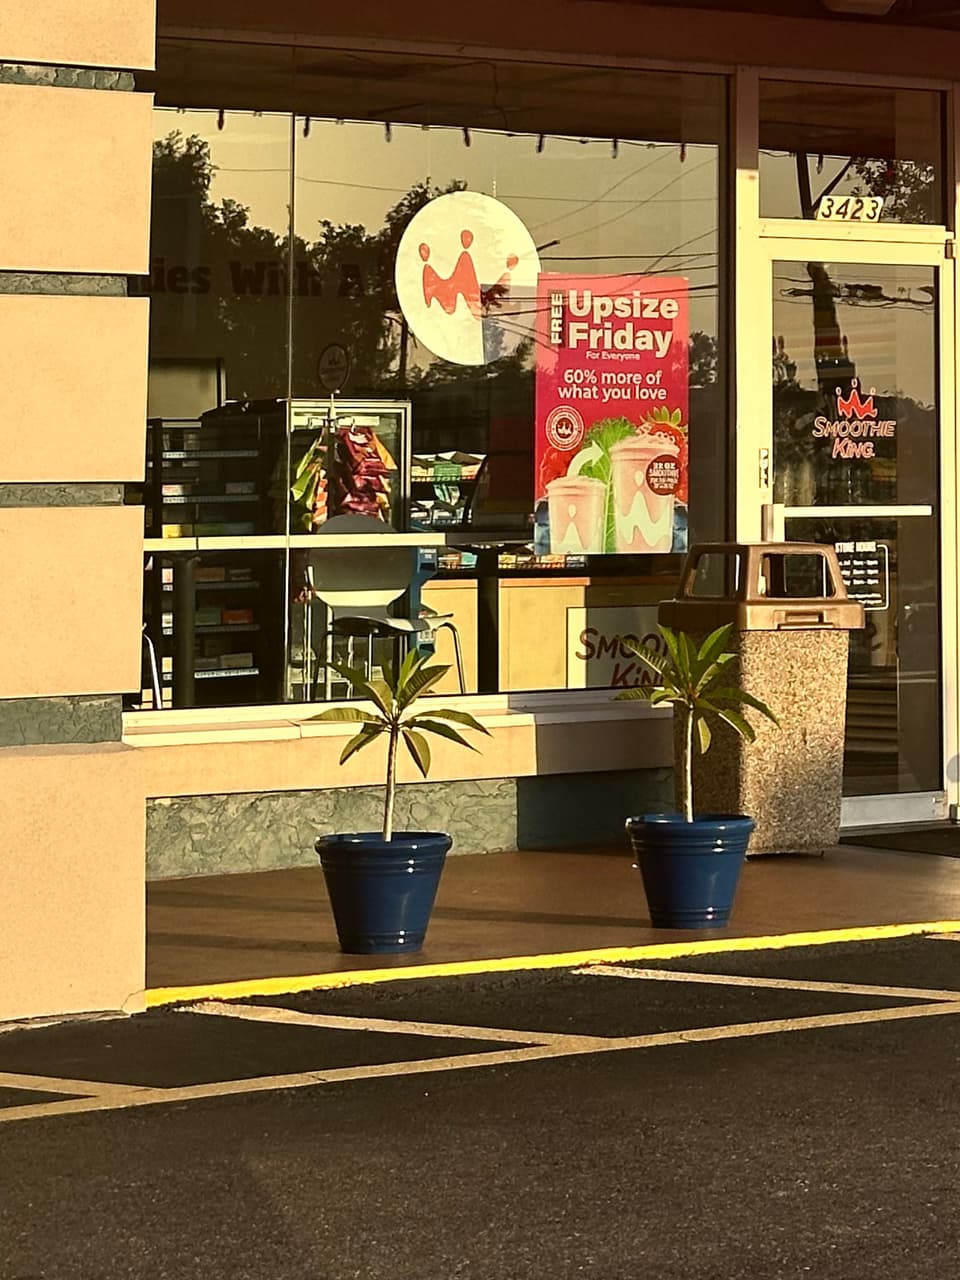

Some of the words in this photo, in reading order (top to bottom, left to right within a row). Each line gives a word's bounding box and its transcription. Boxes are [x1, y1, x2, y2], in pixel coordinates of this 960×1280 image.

[821, 198, 879, 220] 3423
[568, 289, 679, 324] Upsize
[551, 293, 563, 344] FREE
[568, 322, 673, 358] Friday
[586, 351, 600, 360] For
[601, 351, 641, 362] Everyone
[563, 369, 597, 384] 60%
[601, 372, 642, 385] more
[645, 370, 663, 385] of
[558, 384, 599, 399] what
[602, 387, 631, 402] you
[635, 386, 667, 400] love
[812, 416, 896, 438] SMOOTHIE
